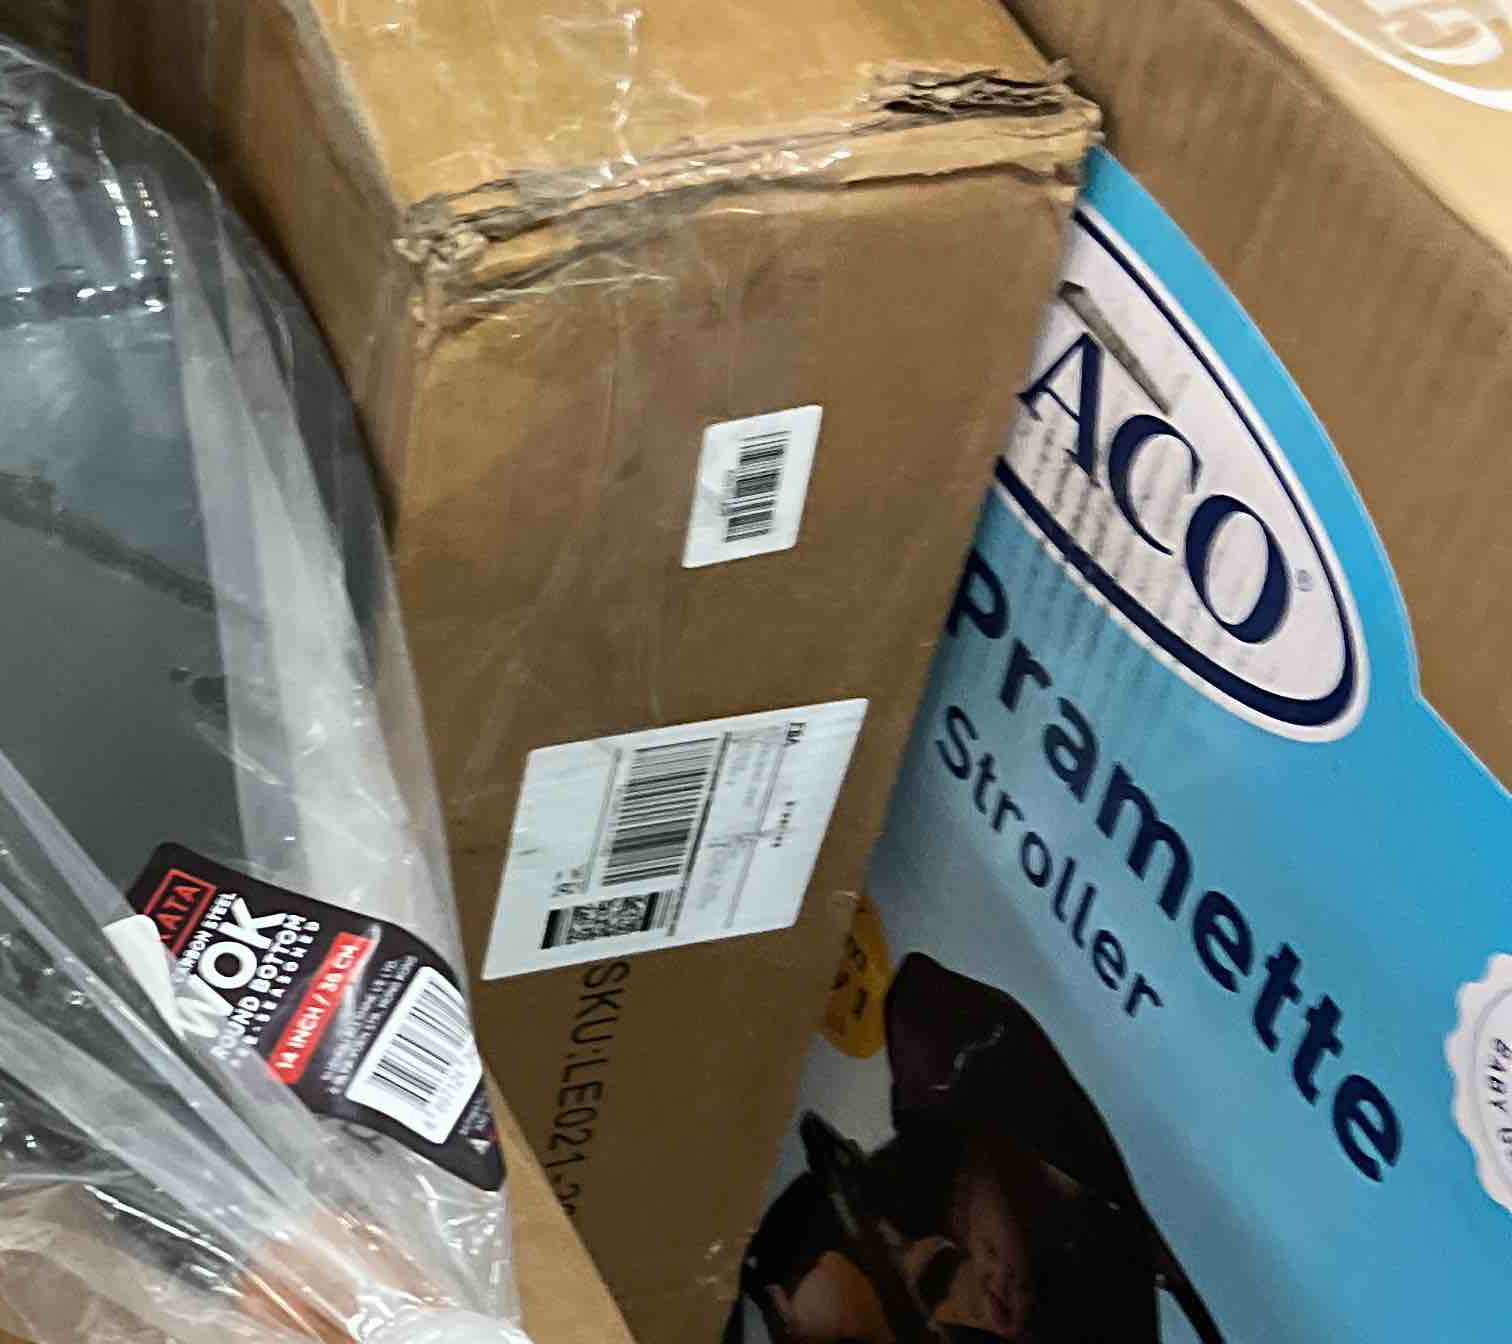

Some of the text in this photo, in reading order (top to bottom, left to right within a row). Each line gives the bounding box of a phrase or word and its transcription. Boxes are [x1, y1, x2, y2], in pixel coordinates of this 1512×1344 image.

[1017, 332, 1290, 644] ACO
[176, 896, 289, 1039] WOK
[253, 913, 307, 994] BOTTOM
[934, 704, 1165, 1019] Stroller
[944, 550, 1403, 1183] Pramette
[291, 1002, 325, 1049] INCH
